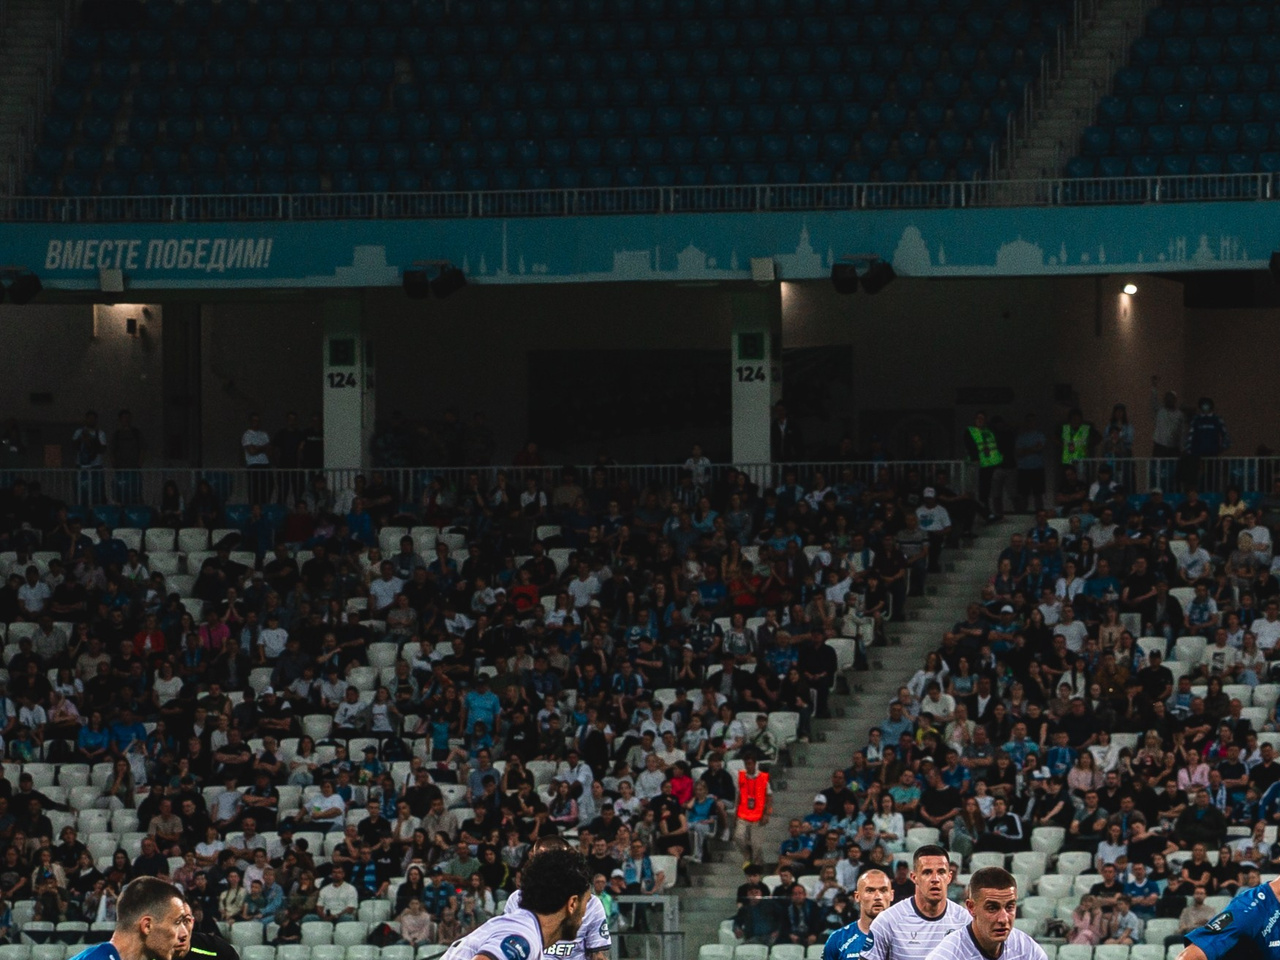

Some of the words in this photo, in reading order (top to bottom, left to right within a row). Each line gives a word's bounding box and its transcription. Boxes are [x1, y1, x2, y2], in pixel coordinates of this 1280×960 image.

[45, 239, 142, 269] ВМЕСТЕ
[145, 238, 273, 272] ПОБЕДИМ!
[328, 372, 356, 388] 124
[736, 366, 765, 382] 124
